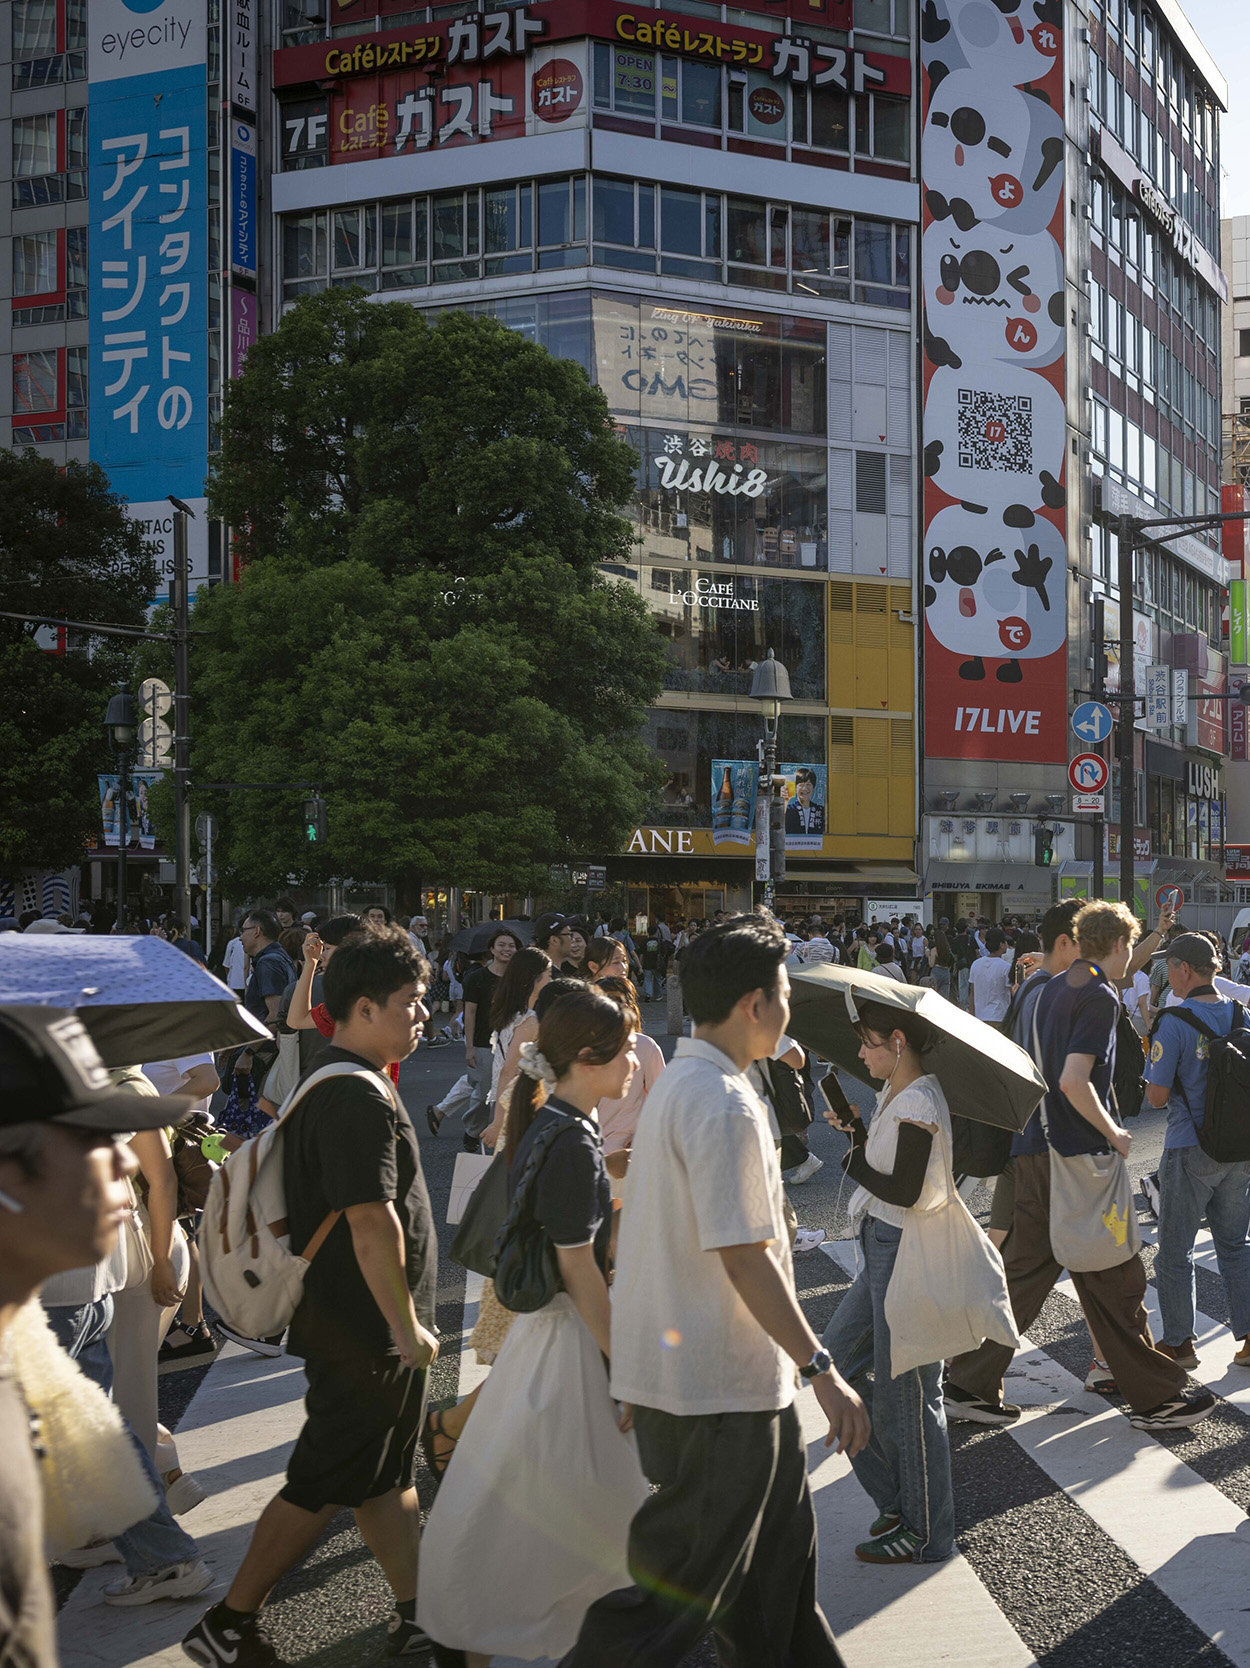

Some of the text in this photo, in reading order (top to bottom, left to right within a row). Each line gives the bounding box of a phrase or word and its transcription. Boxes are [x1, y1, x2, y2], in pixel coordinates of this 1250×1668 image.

[101, 16, 192, 60] eyecity
[448, 8, 543, 62] ガスト
[1038, 29, 1057, 49] れ
[616, 54, 653, 72] OPEN
[773, 38, 885, 92] ガスト
[538, 87, 578, 107] ガスト
[616, 73, 653, 91] 7:30
[339, 104, 389, 134] Café
[396, 82, 513, 151] ガスト
[754, 101, 782, 115] ガスト
[286, 114, 328, 152] 7F
[340, 132, 388, 153] レストラン
[998, 181, 1015, 200] よ
[101, 132, 149, 434] アイシティ
[158, 126, 193, 431] コンタクトの
[651, 309, 680, 324] King
[704, 316, 761, 333] Yakiniku
[1012, 326, 1030, 343] ん
[654, 455, 769, 498] Ushi8
[1005, 626, 1023, 643] で
[1232, 608, 1242, 635] レイク
[1155, 670, 1167, 724] 渋谷駅前
[1176, 672, 1185, 722] スクランブル式
[954, 706, 1042, 735] 17LIVE
[1233, 710, 1245, 743] アコム
[1188, 761, 1219, 800] LUSH
